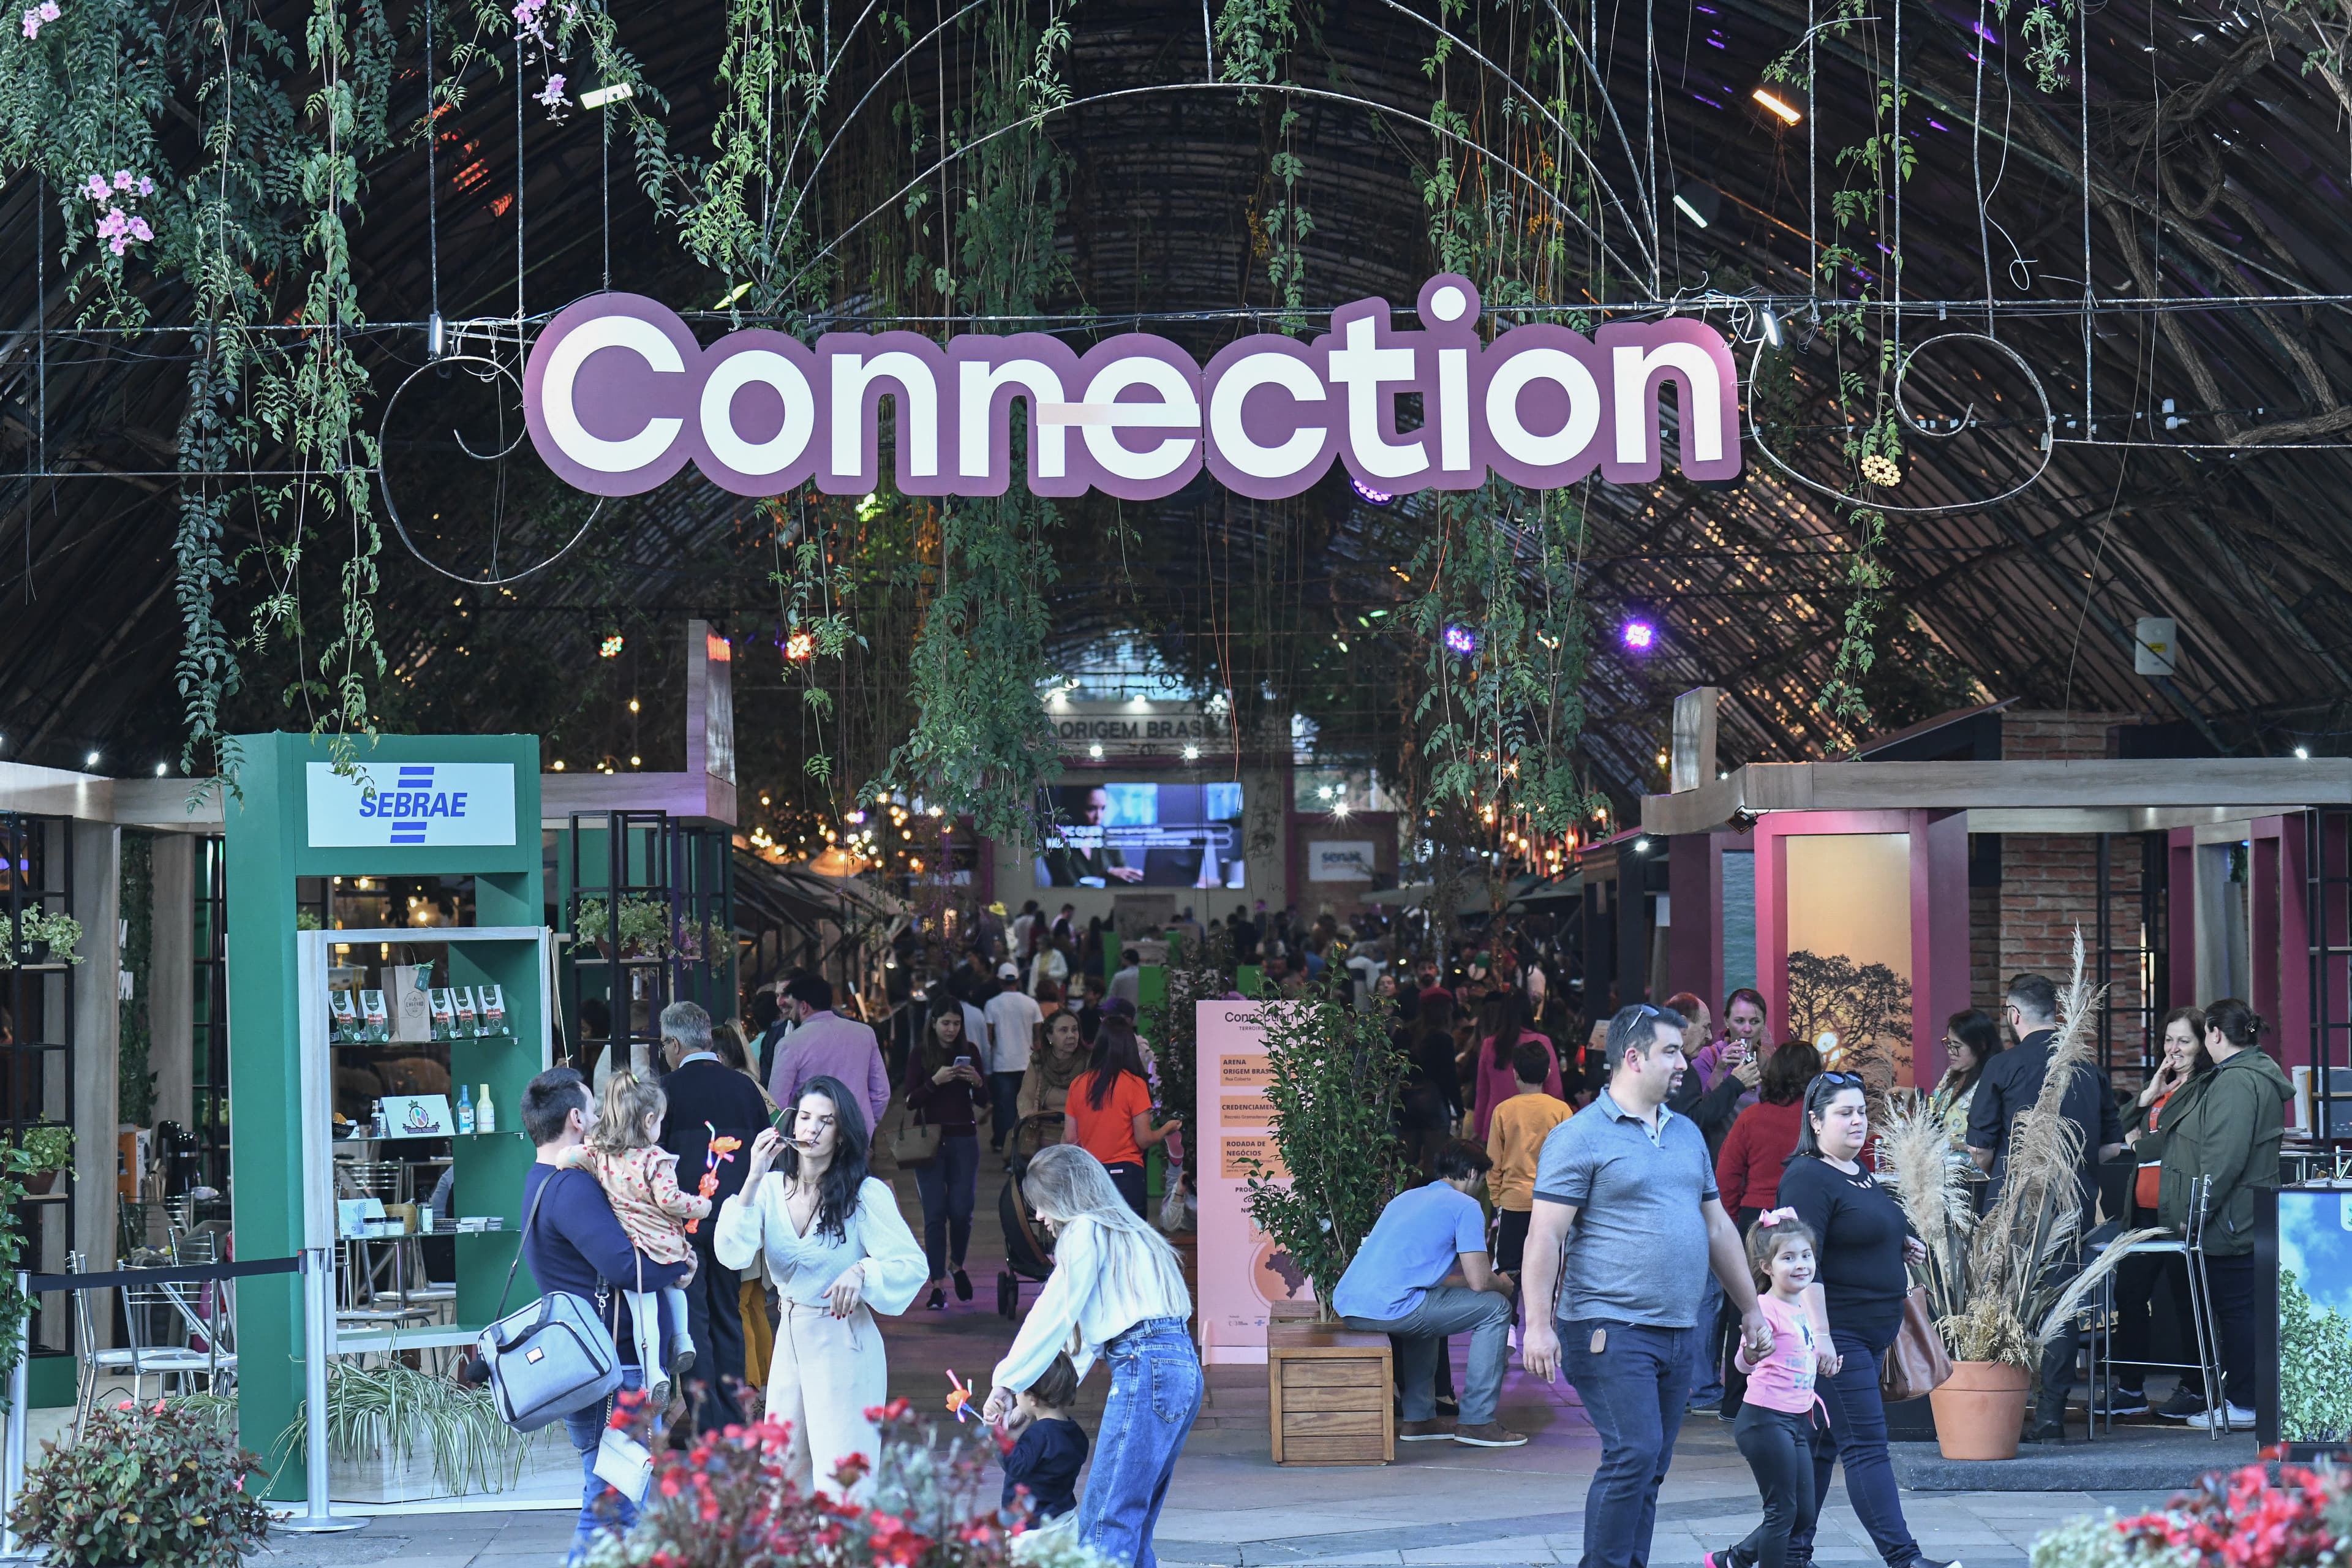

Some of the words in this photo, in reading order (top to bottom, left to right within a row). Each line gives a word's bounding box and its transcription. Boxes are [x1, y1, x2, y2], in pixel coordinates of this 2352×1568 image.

[542, 287, 1722, 479] Connection
[1059, 720, 1138, 739] ORIGEM
[360, 792, 467, 817] SEBRAE
